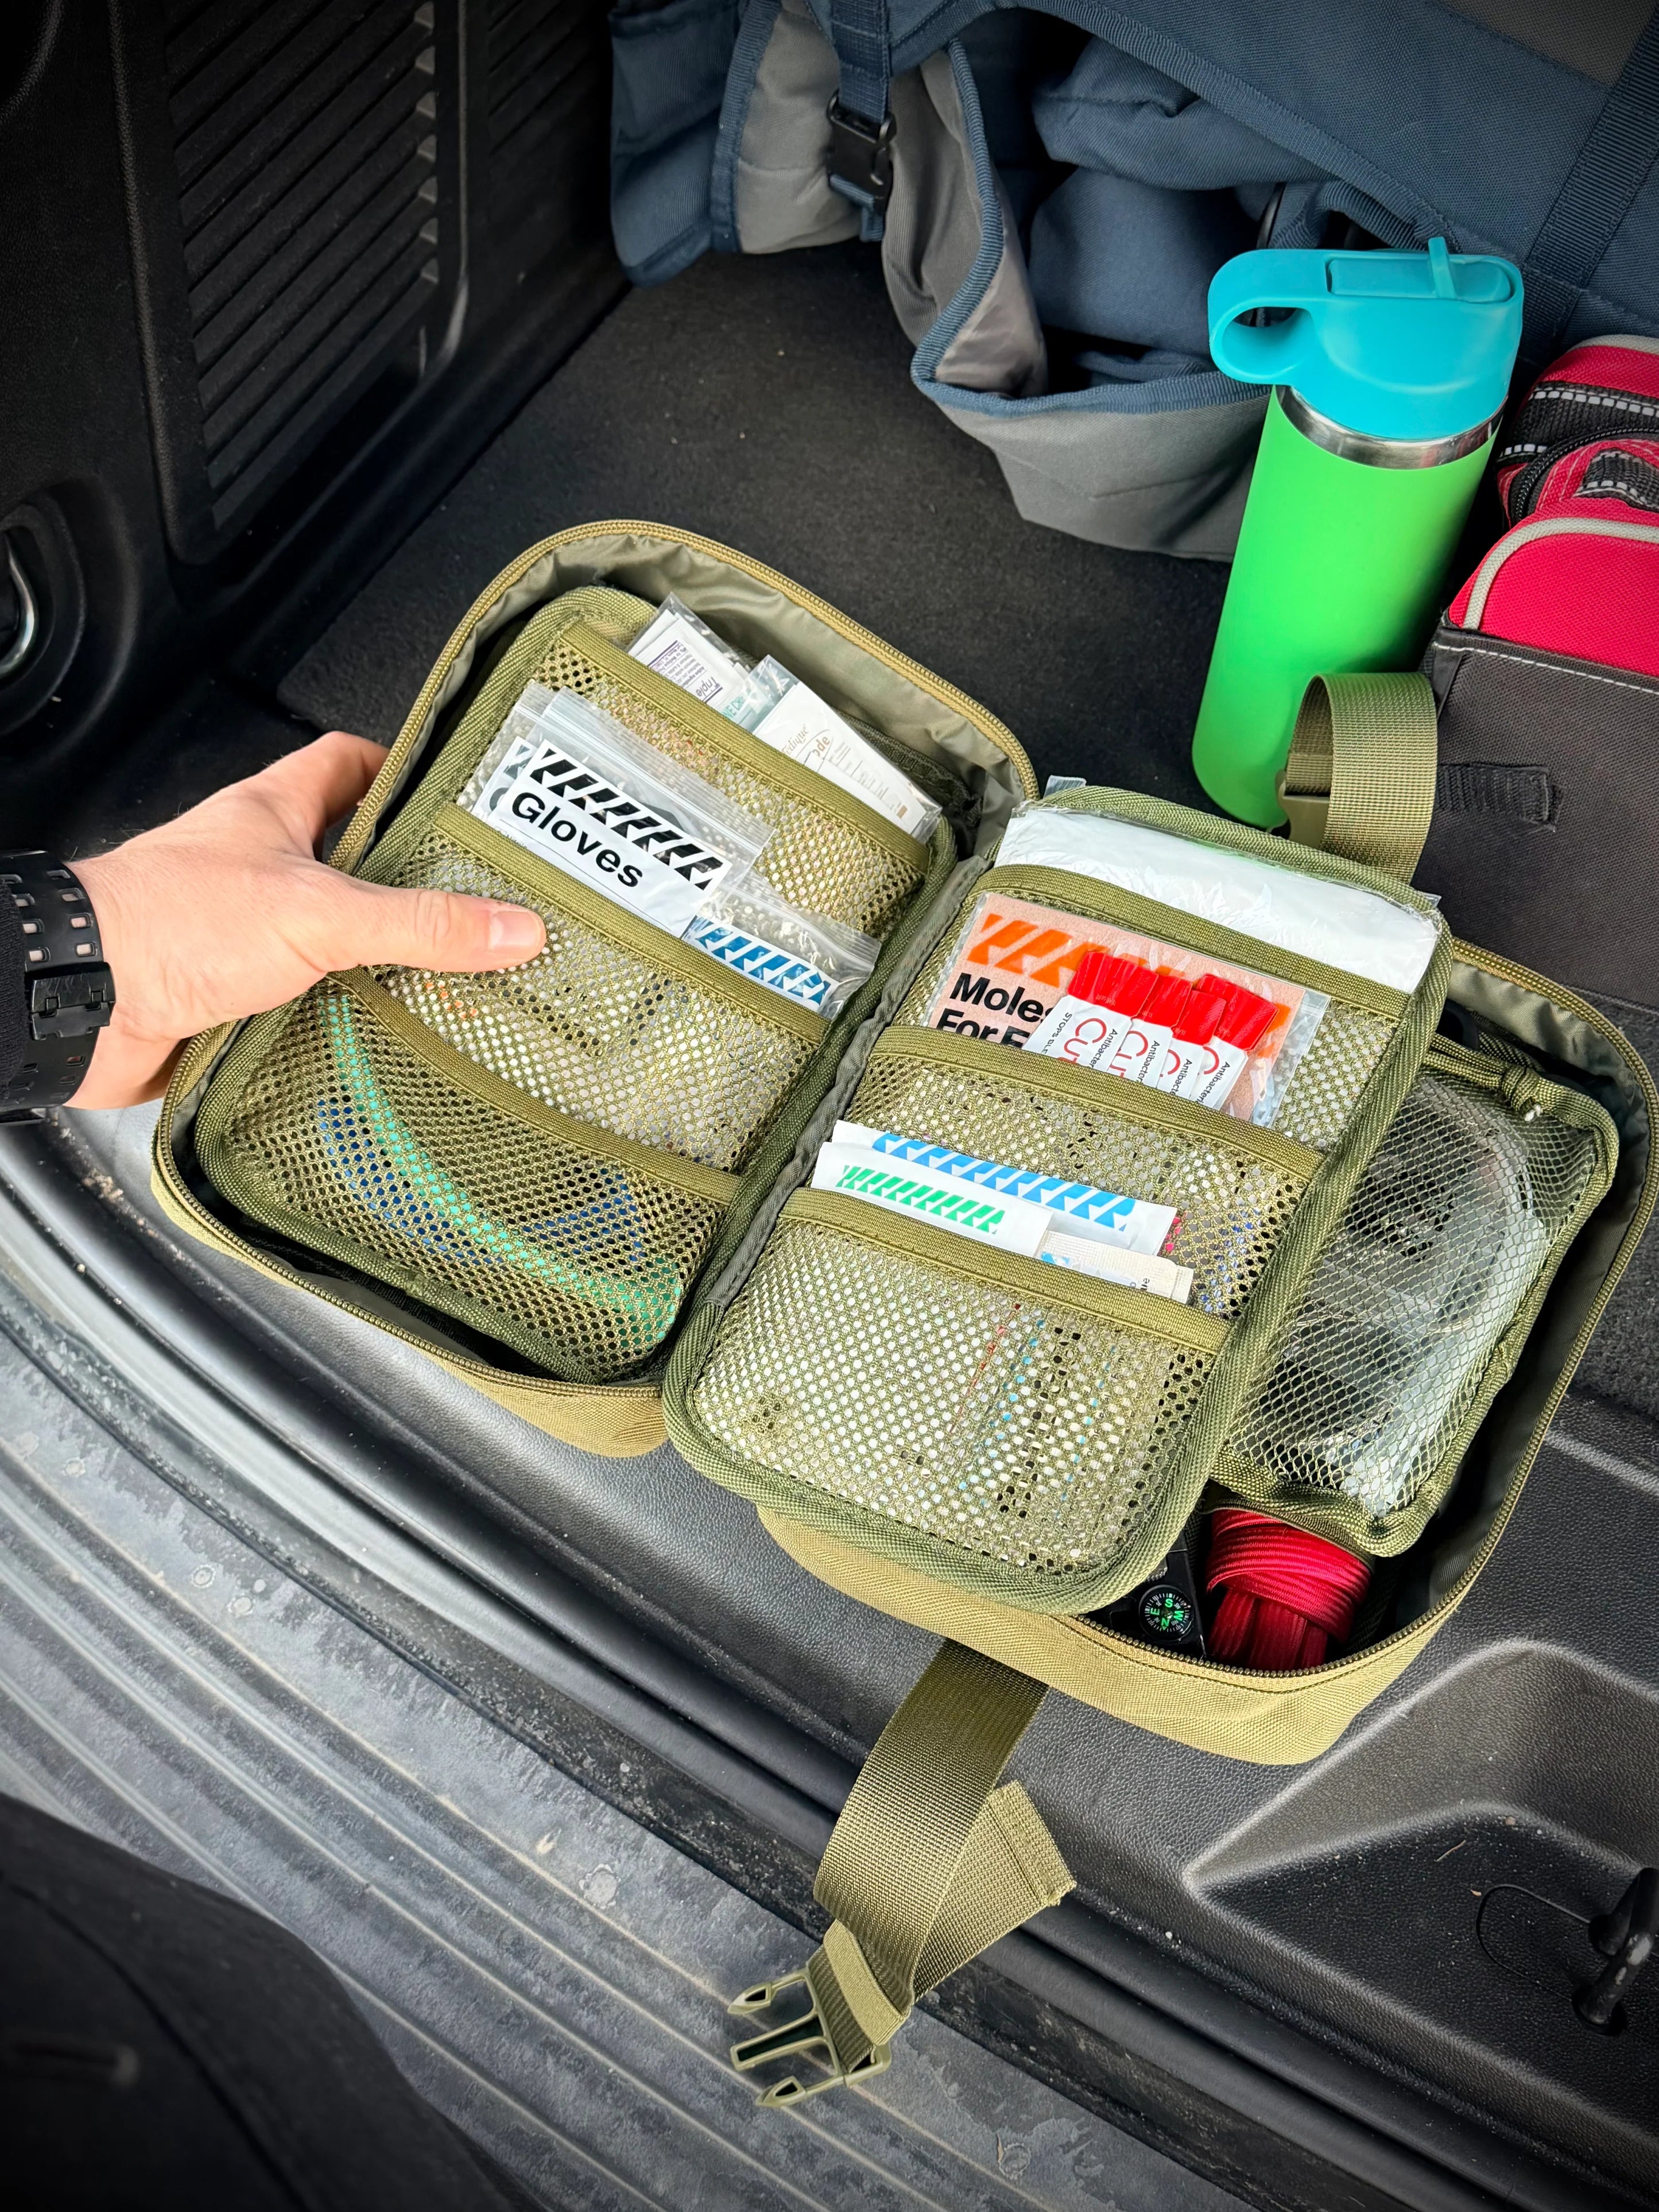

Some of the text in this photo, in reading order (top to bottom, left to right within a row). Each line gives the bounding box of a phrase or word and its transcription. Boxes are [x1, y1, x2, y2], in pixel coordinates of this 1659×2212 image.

[696, 676, 720, 697] Triple
[512, 792, 643, 888] Gloves
[1052, 1012, 1073, 1038] STOPS
[1136, 1040, 1161, 1084] Antibacter
[1195, 1061, 1231, 1103] Antibacteri
[1150, 1607, 1160, 1616] E
[1165, 1598, 1173, 1608] S
[1161, 1617, 1170, 1627] N
[1173, 1610, 1184, 1621] W
